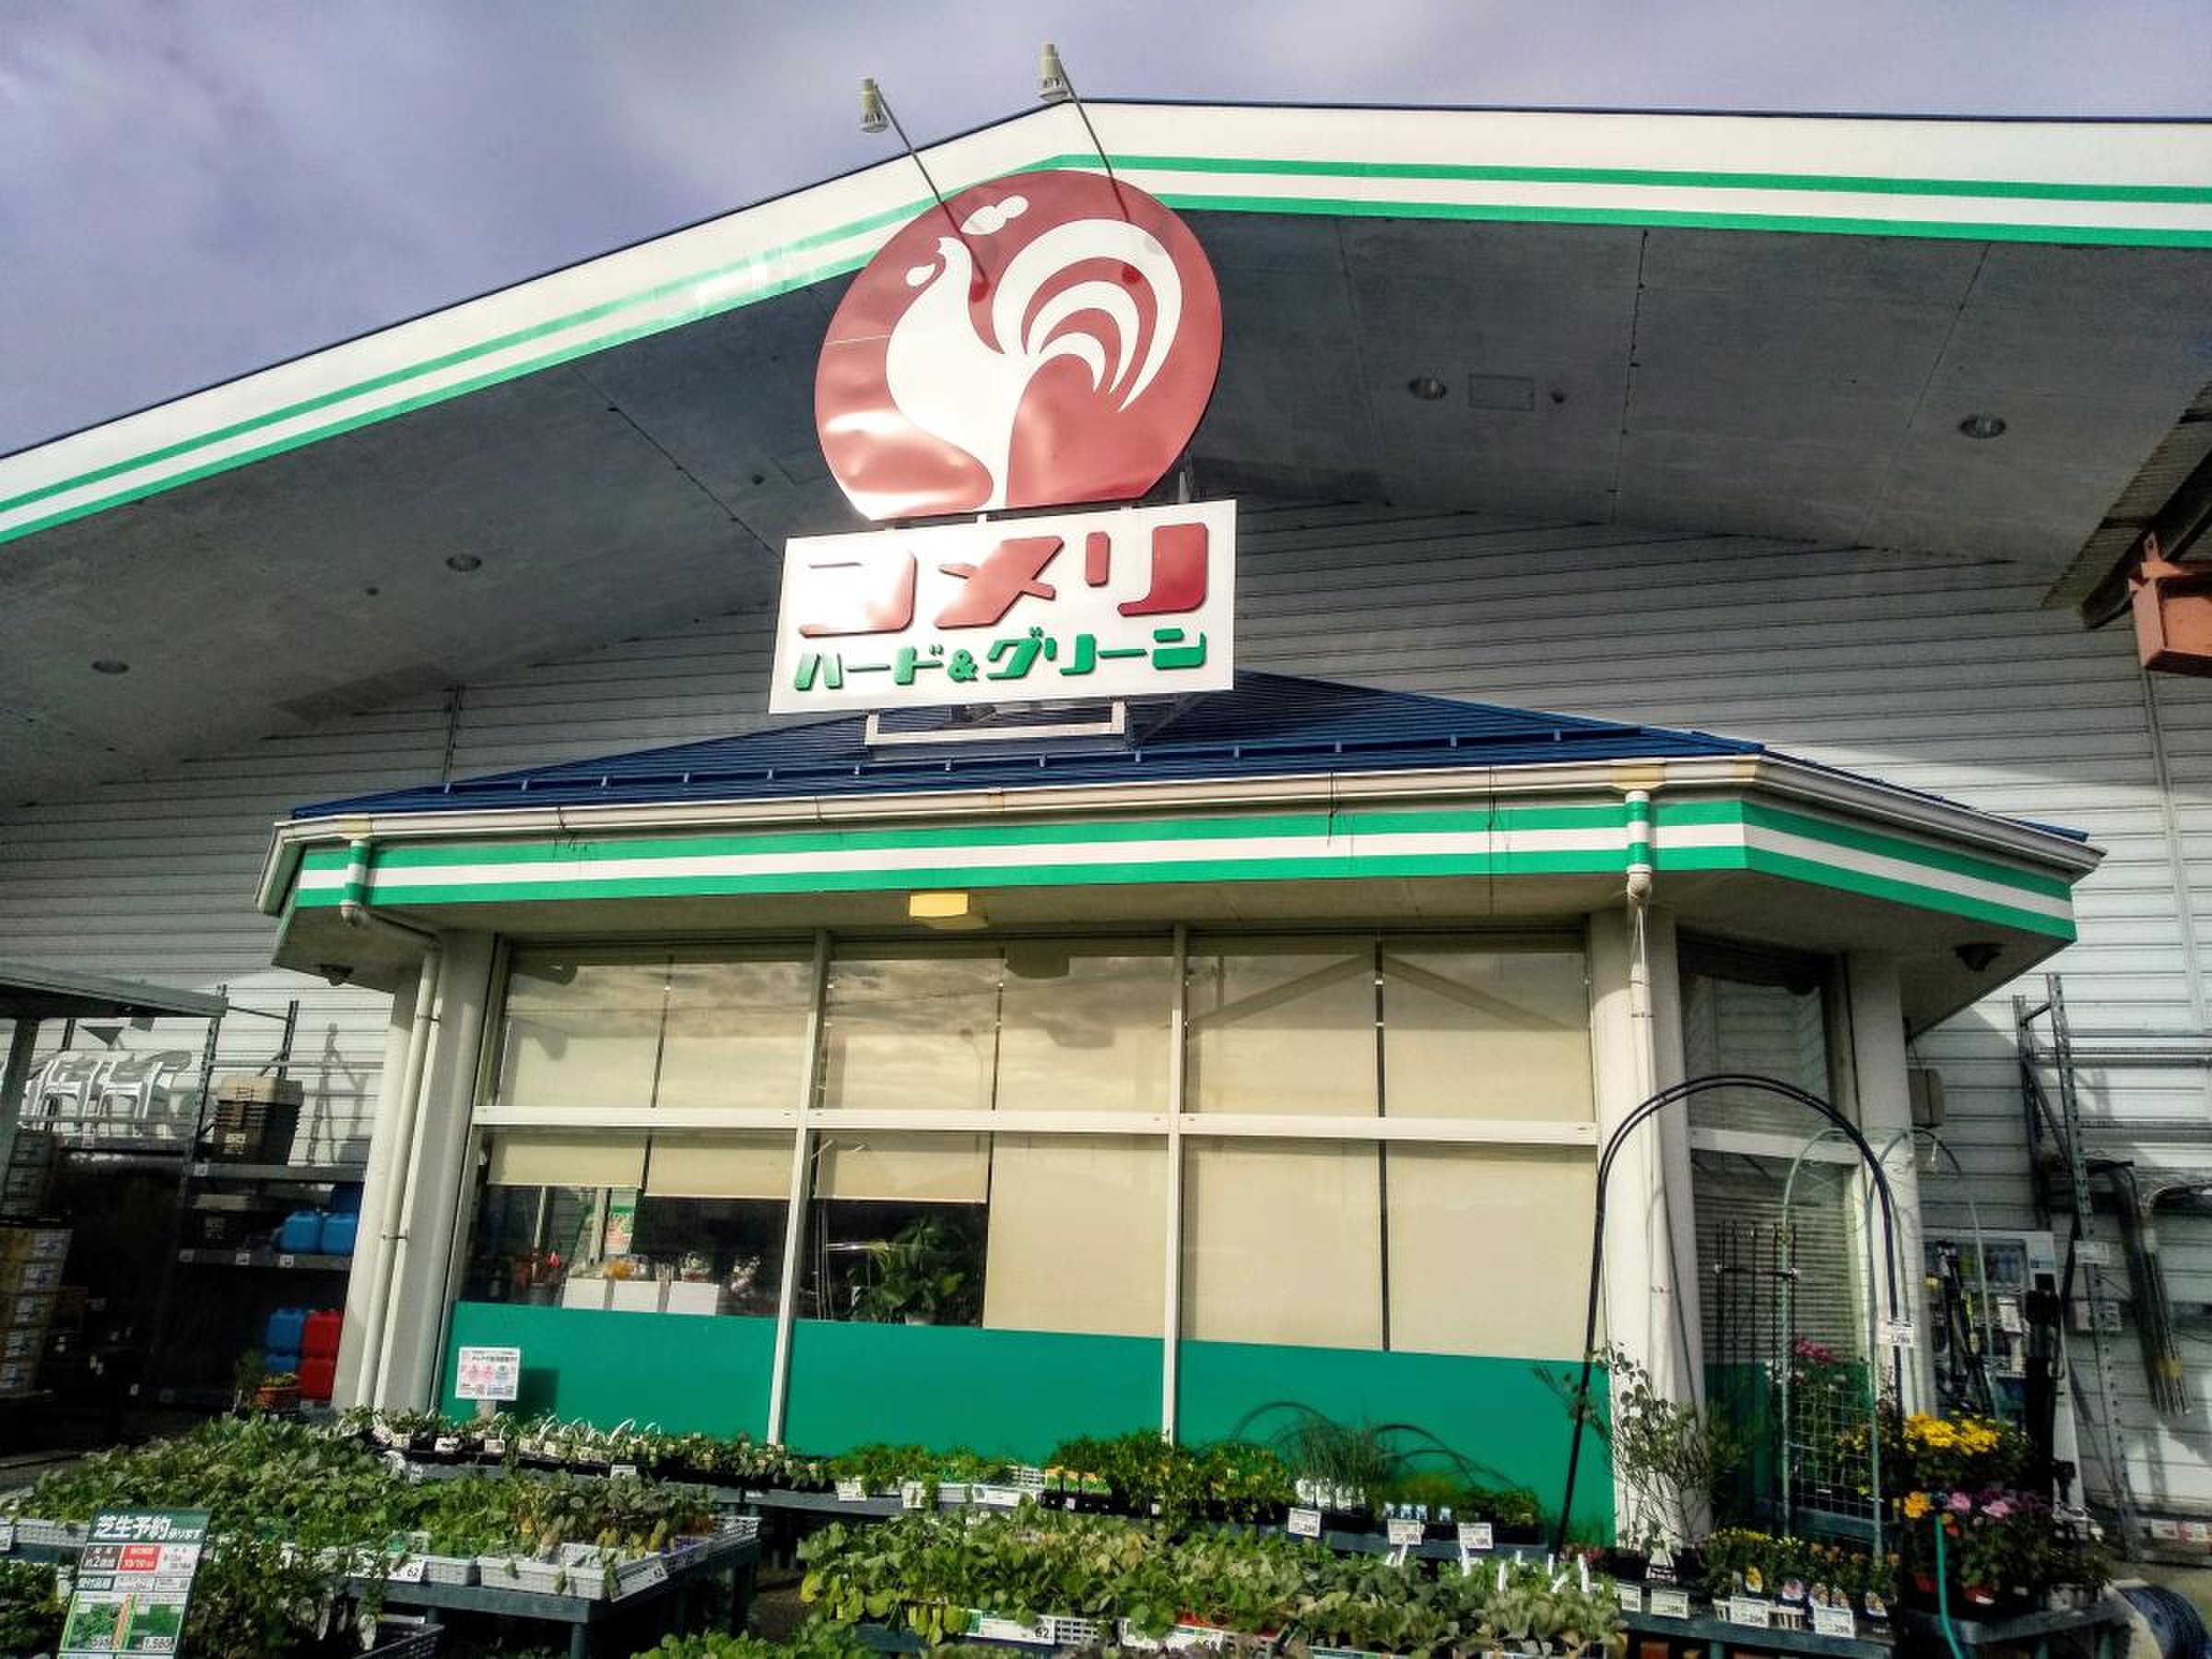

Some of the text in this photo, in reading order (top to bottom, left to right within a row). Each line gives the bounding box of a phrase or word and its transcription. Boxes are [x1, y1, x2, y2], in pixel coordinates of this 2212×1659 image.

[799, 522, 1208, 638] コメリ
[794, 626, 1206, 690] ハード&グリーン
